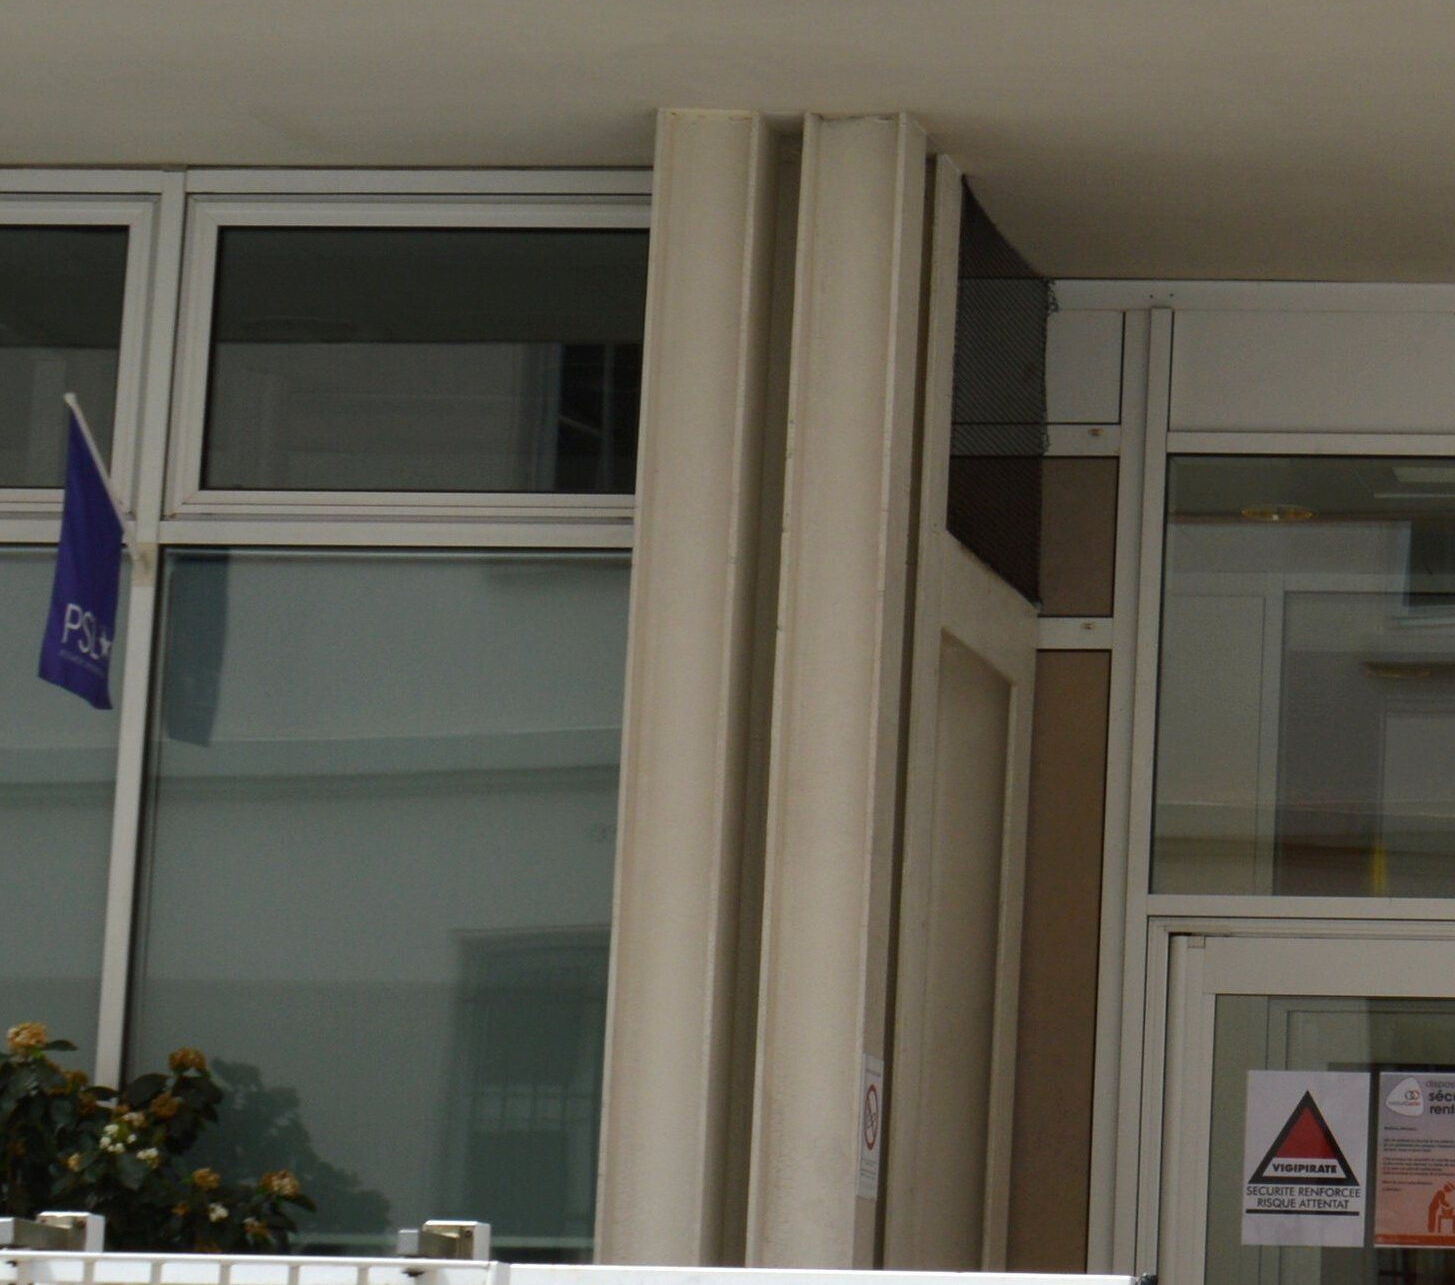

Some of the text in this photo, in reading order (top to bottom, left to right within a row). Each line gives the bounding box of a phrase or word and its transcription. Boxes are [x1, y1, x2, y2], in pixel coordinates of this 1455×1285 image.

[1272, 1163, 1338, 1174] VIGIPIRATE
[1246, 1186, 1361, 1198] SECURITE RENFORCEE
[1257, 1198, 1349, 1209] RISQUE ATTENTAT
